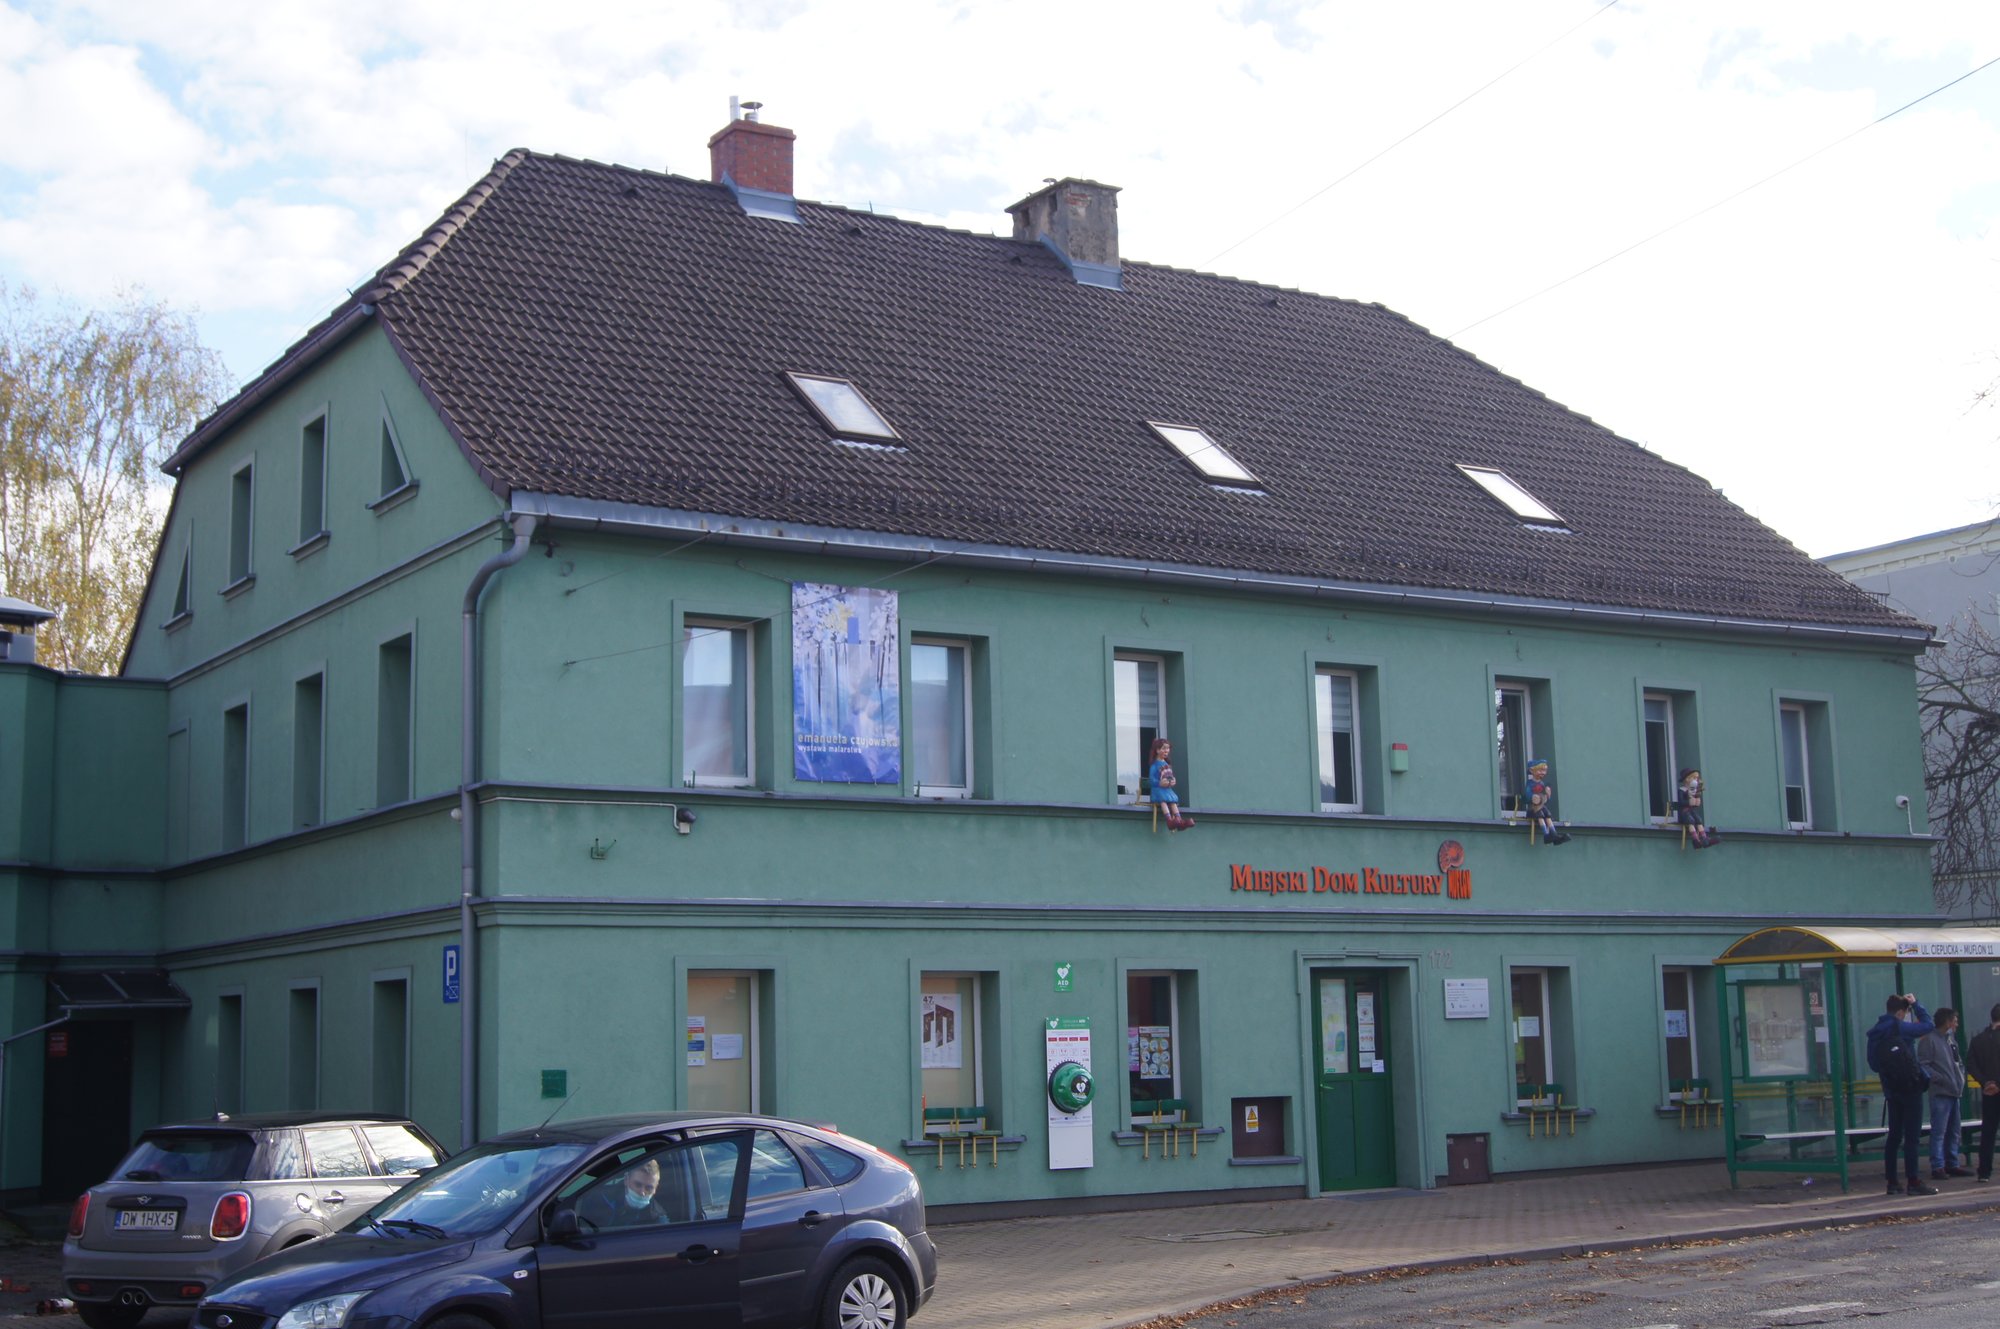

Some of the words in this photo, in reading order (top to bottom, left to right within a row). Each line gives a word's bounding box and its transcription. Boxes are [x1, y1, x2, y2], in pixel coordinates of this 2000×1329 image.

[798, 733, 848, 745] emanuela
[798, 744, 827, 753] wystawa
[829, 745, 862, 754] malarstwa
[1931, 944, 1958, 955] CIEPLICKA
[1963, 944, 1986, 955] MUFLON
[1987, 944, 1994, 955] 11
[1428, 950, 1454, 969] 172
[446, 950, 457, 986] P
[122, 1212, 136, 1227] DW
[141, 1212, 175, 1227] 1HX45
